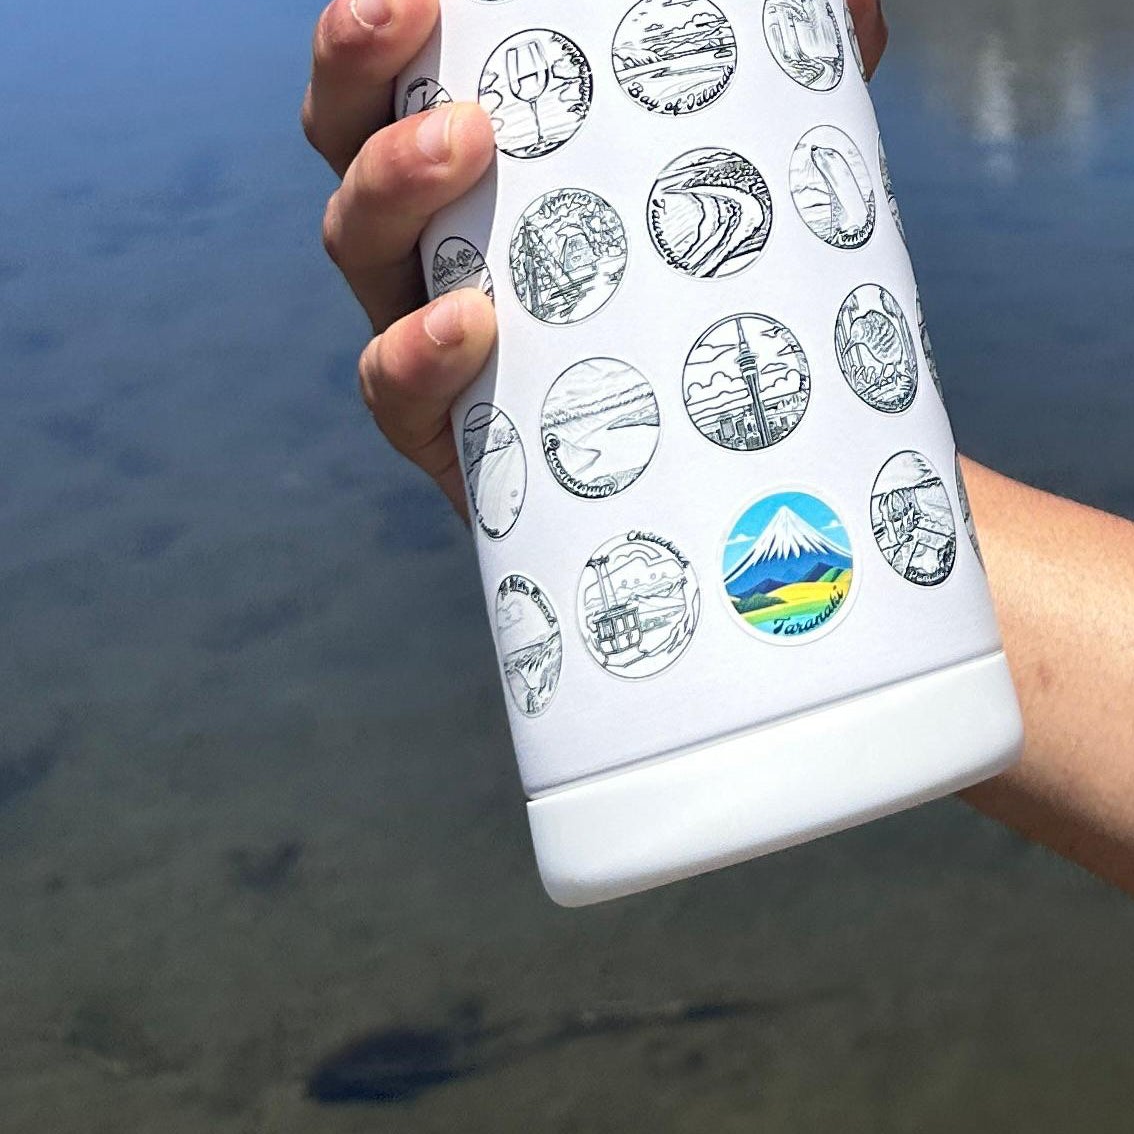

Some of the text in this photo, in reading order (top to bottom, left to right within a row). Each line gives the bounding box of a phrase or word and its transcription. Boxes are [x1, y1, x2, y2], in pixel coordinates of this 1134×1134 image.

[627, 65, 735, 116] Bay of Islands
[652, 198, 691, 271] Tauranga
[627, 530, 689, 568] Christchurch
[773, 584, 844, 635] Taranaki
